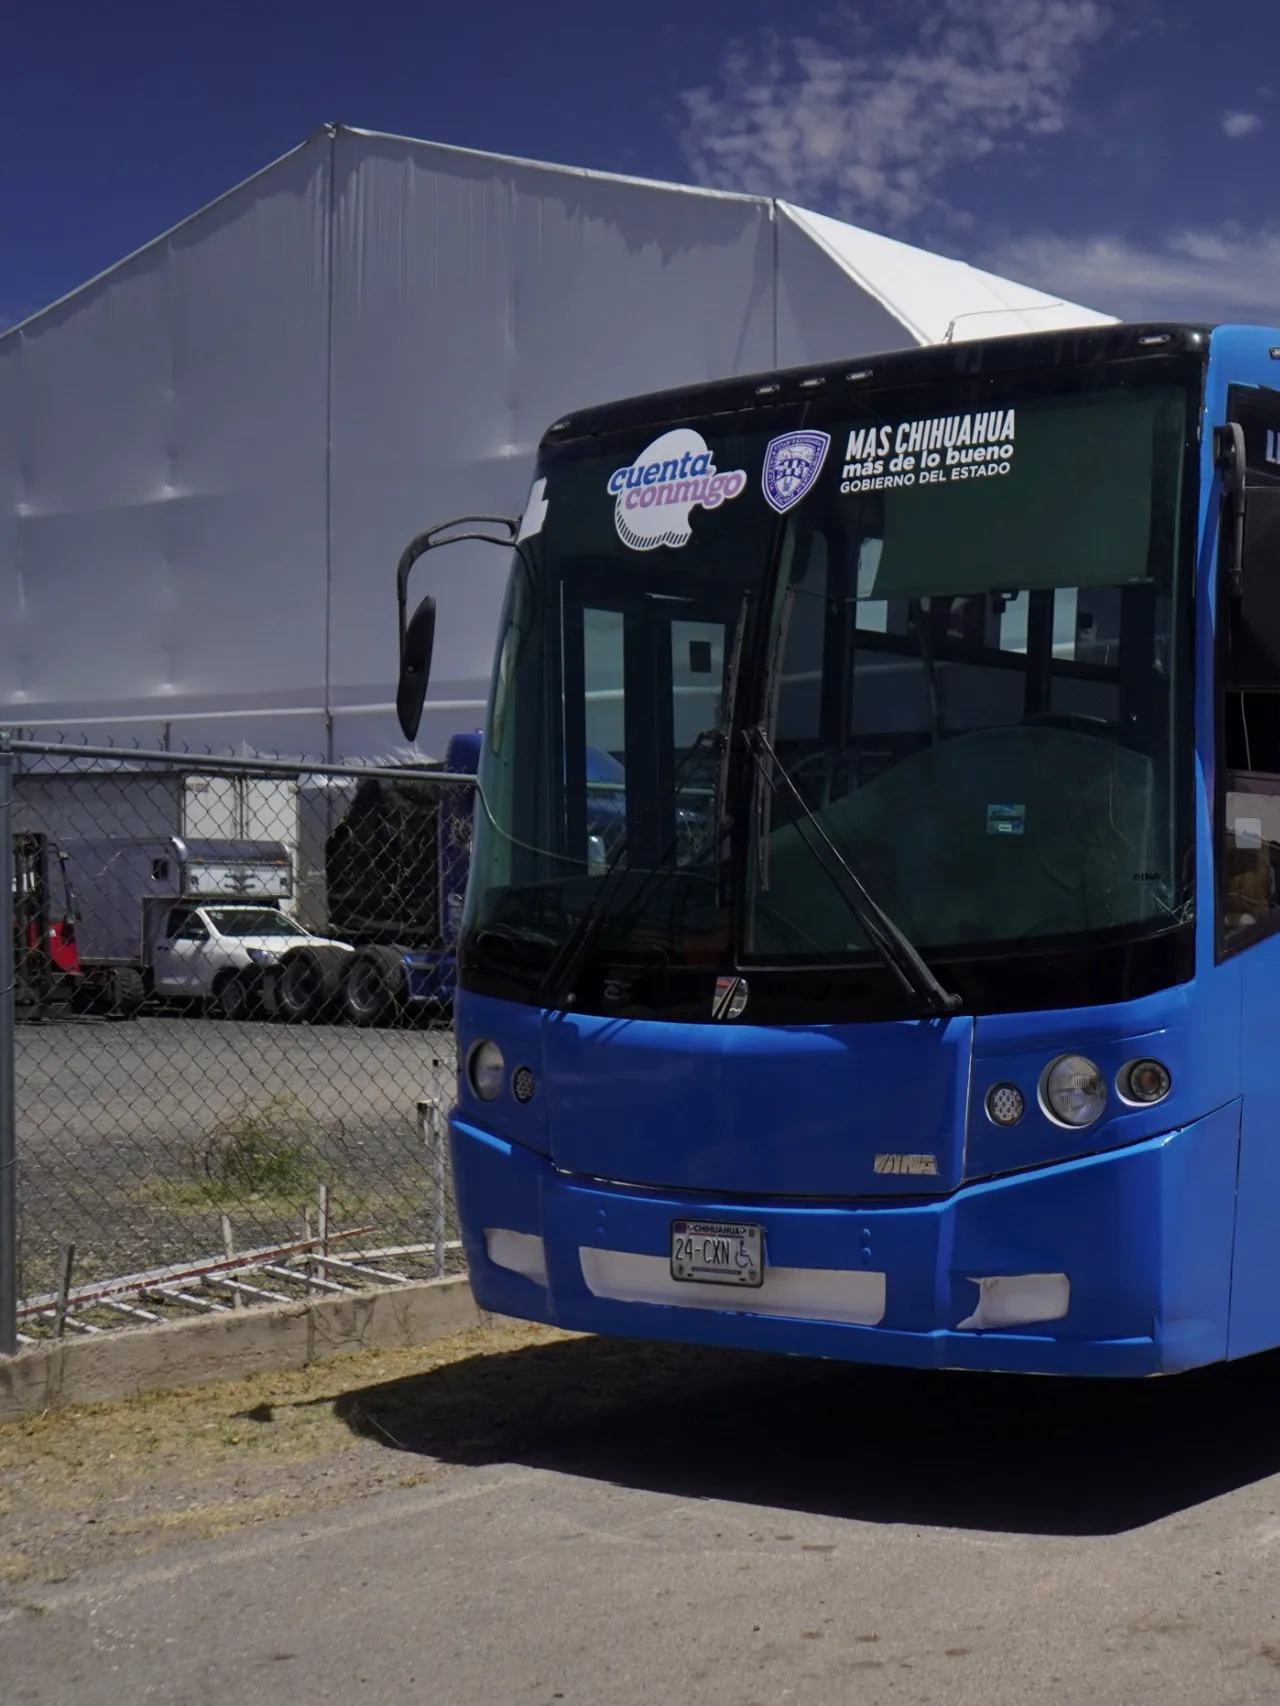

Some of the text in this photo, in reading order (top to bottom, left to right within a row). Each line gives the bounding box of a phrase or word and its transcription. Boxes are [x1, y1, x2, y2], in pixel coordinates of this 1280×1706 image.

[895, 409, 1015, 454] CHIHUAHUA
[610, 451, 711, 492] cuenta
[840, 462, 1011, 493] GOBIERNO DEL ESTADO
[842, 456, 884, 478] más
[889, 453, 916, 473] de
[920, 450, 940, 468] lo
[946, 444, 1014, 465] bueno
[625, 473, 743, 509] conmigo
[693, 1224, 740, 1235] CHIHUAHUA
[675, 1237, 730, 1265] 24-CXN
